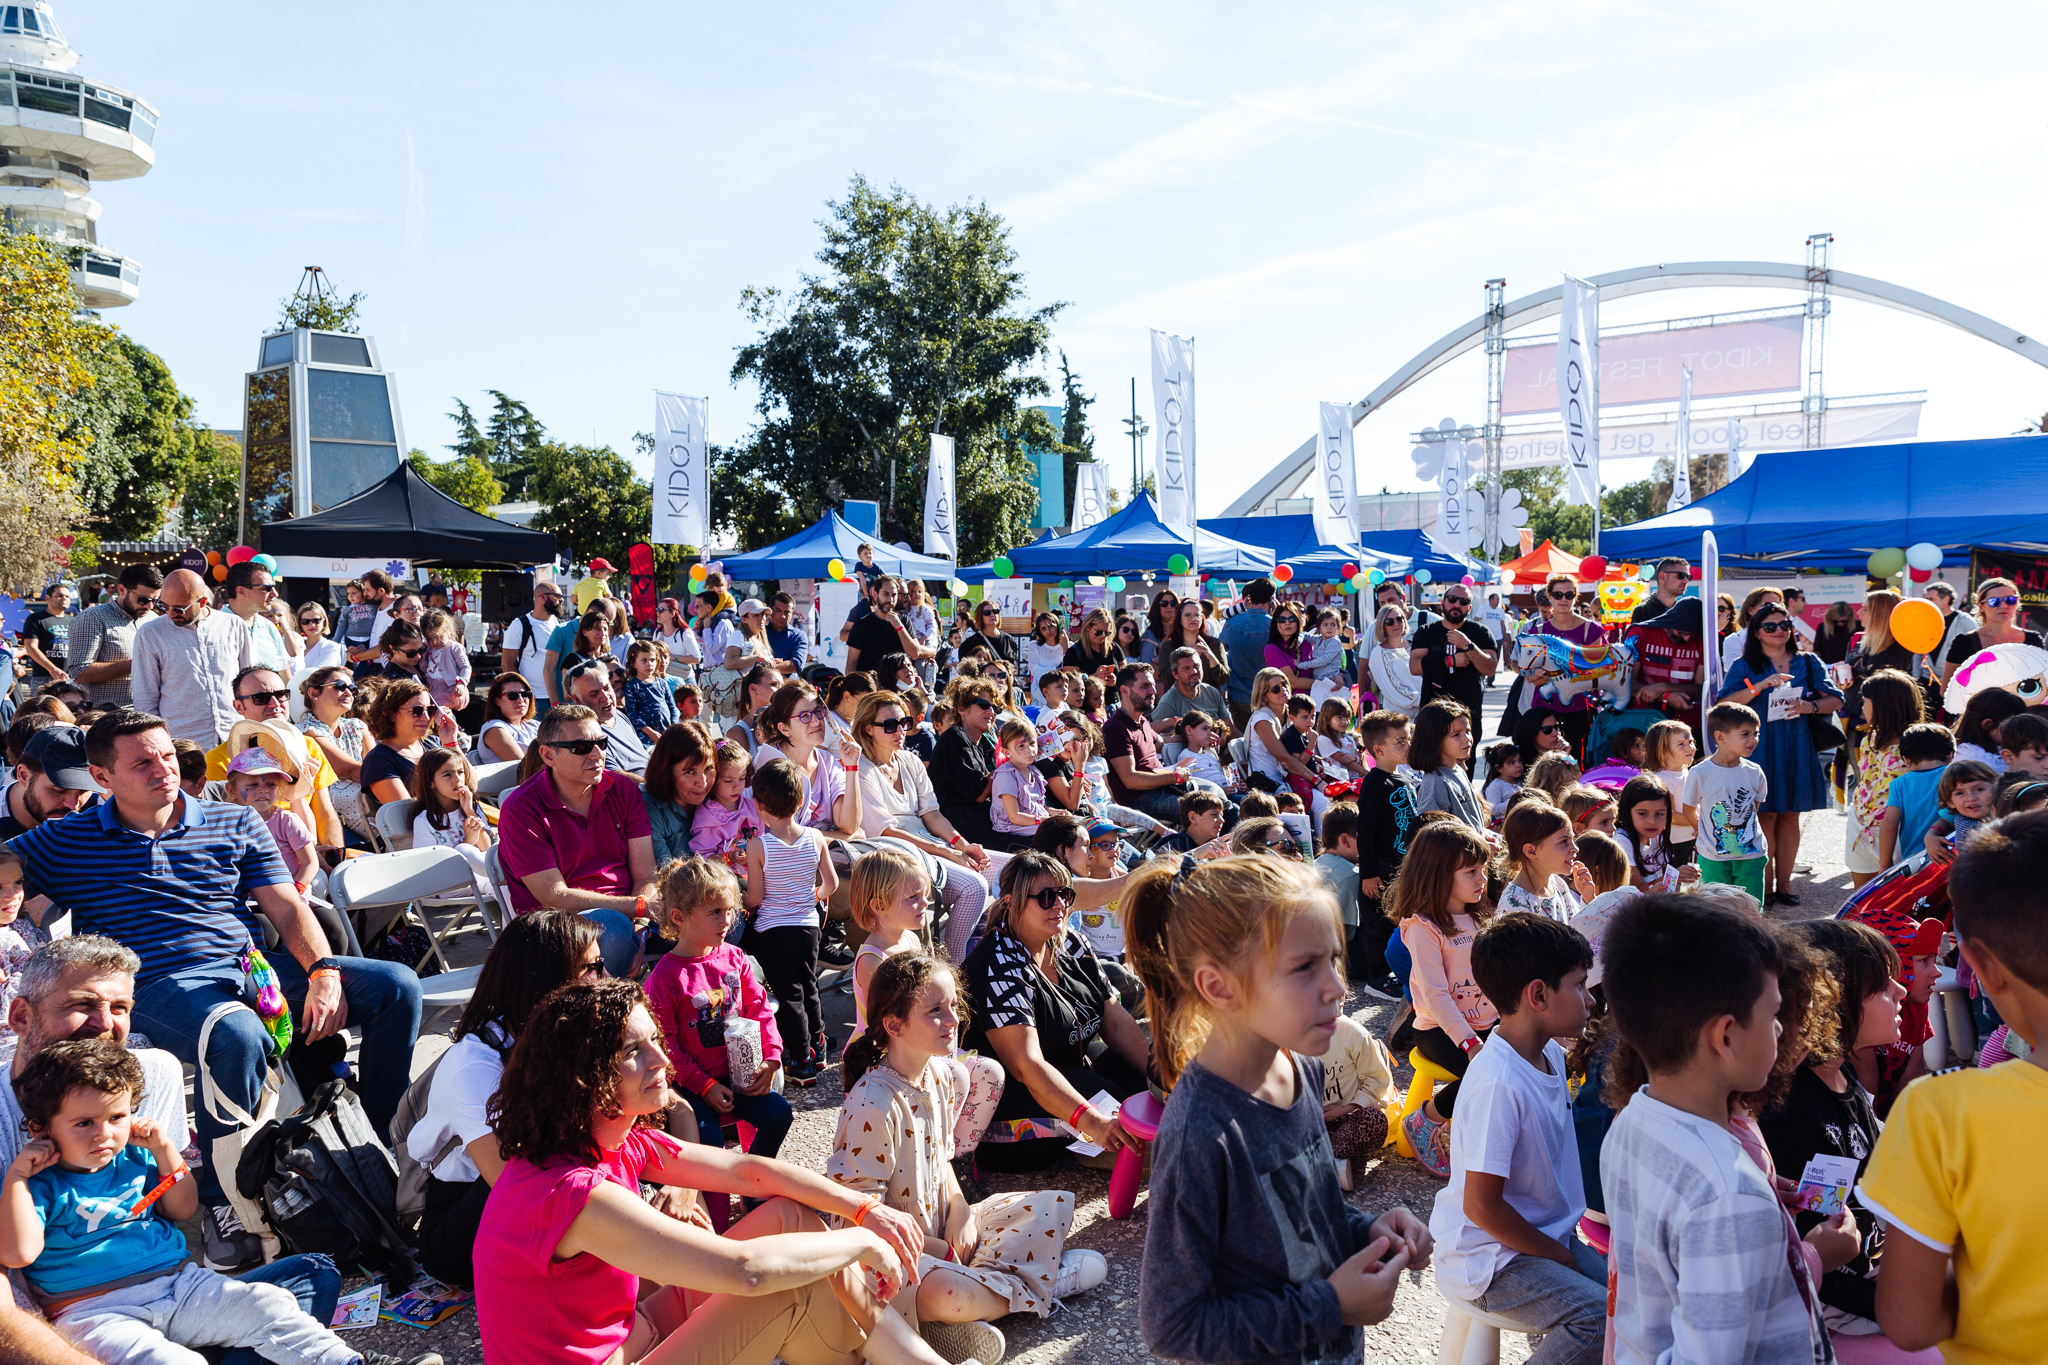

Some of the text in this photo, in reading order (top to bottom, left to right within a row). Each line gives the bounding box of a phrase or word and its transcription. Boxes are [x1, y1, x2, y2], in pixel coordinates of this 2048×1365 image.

[1163, 371, 1184, 491] KIDOT
[1567, 324, 1589, 469] KIDOT
[667, 424, 690, 518] KIDOT
[1327, 428, 1348, 520] KIDOT
[1445, 461, 1461, 535] KIDOT
[183, 559, 204, 567] KIDOT
[331, 562, 349, 573] DJ
[1453, 935, 1474, 946] BESTIES
